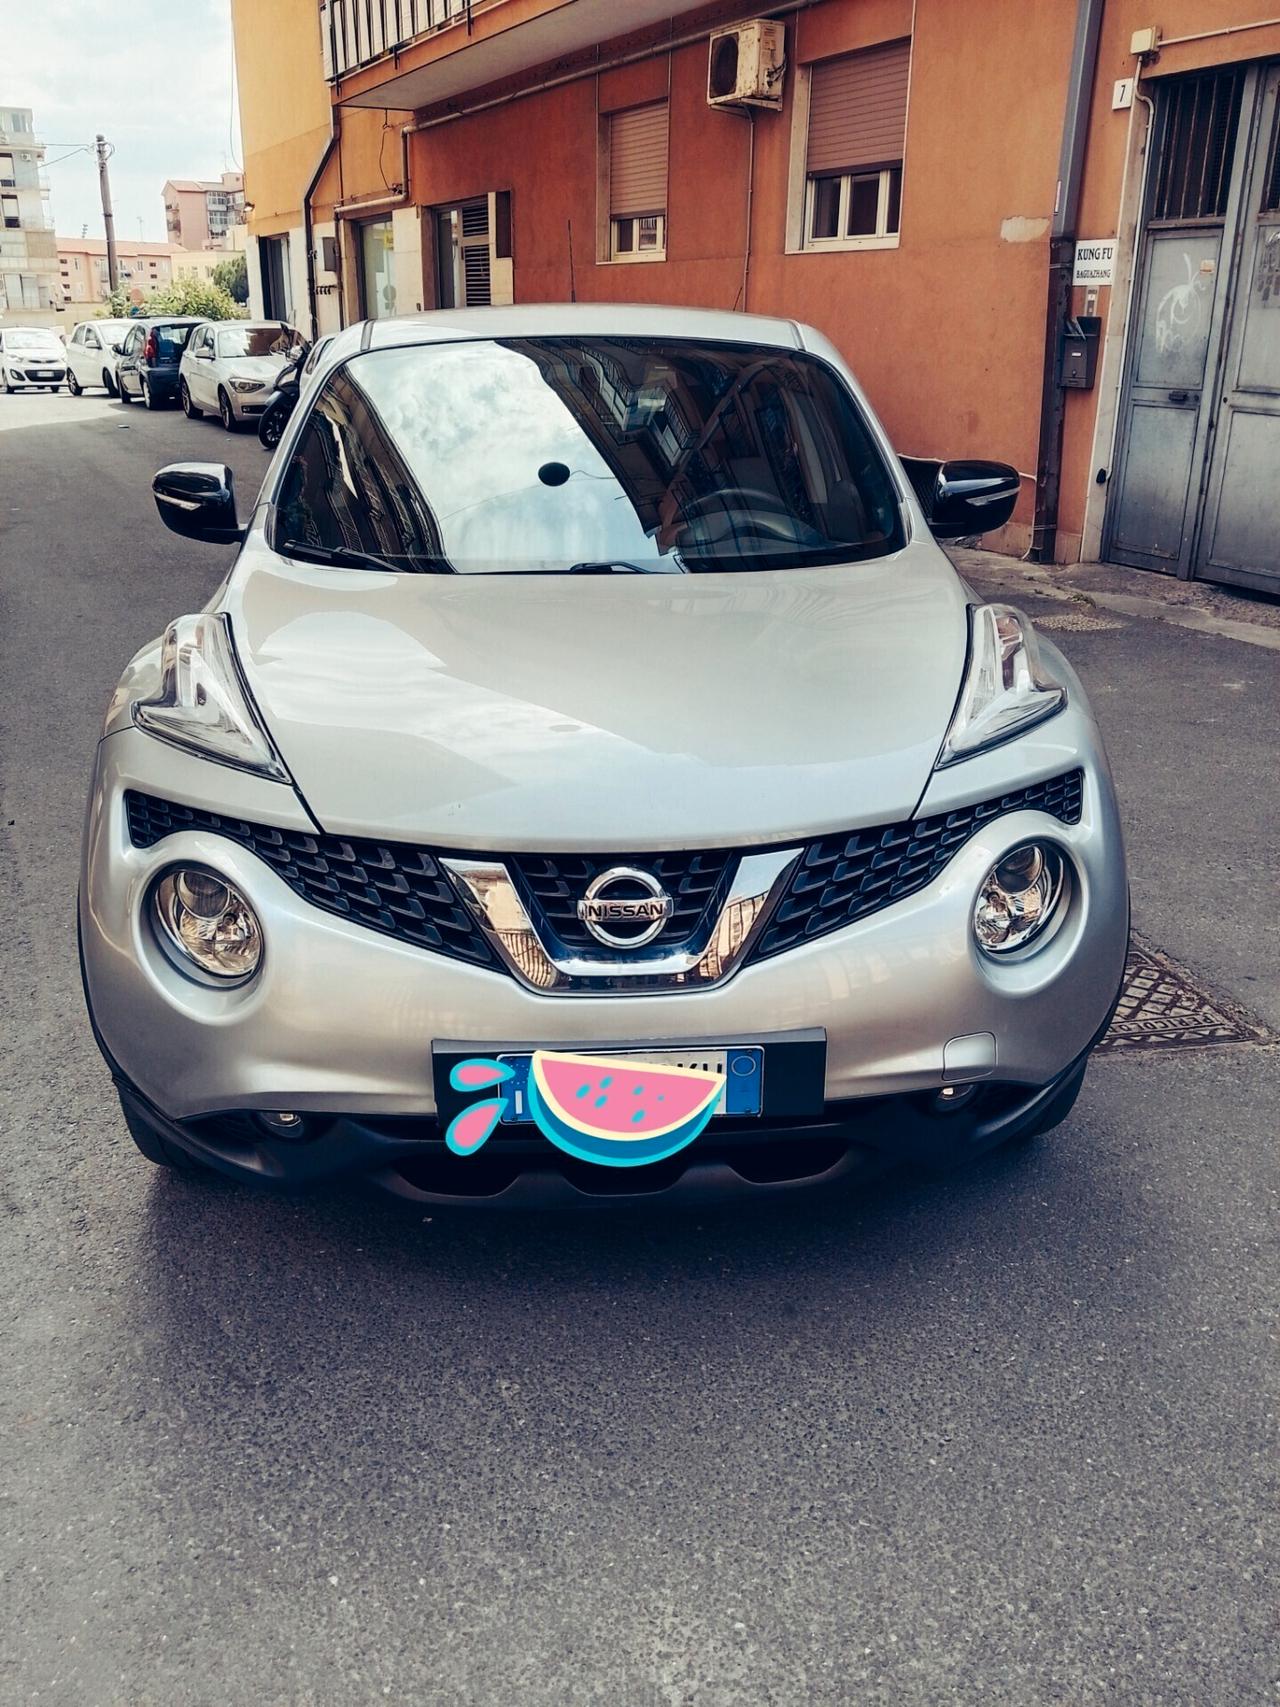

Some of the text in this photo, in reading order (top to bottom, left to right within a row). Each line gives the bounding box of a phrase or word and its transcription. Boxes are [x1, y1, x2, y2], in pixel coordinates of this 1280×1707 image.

[1120, 84, 1126, 102] 7
[1077, 247, 1113, 260] KUNG FU
[588, 904, 663, 917] NISSAN
[1119, 1013, 1214, 1031] PERICOLO
